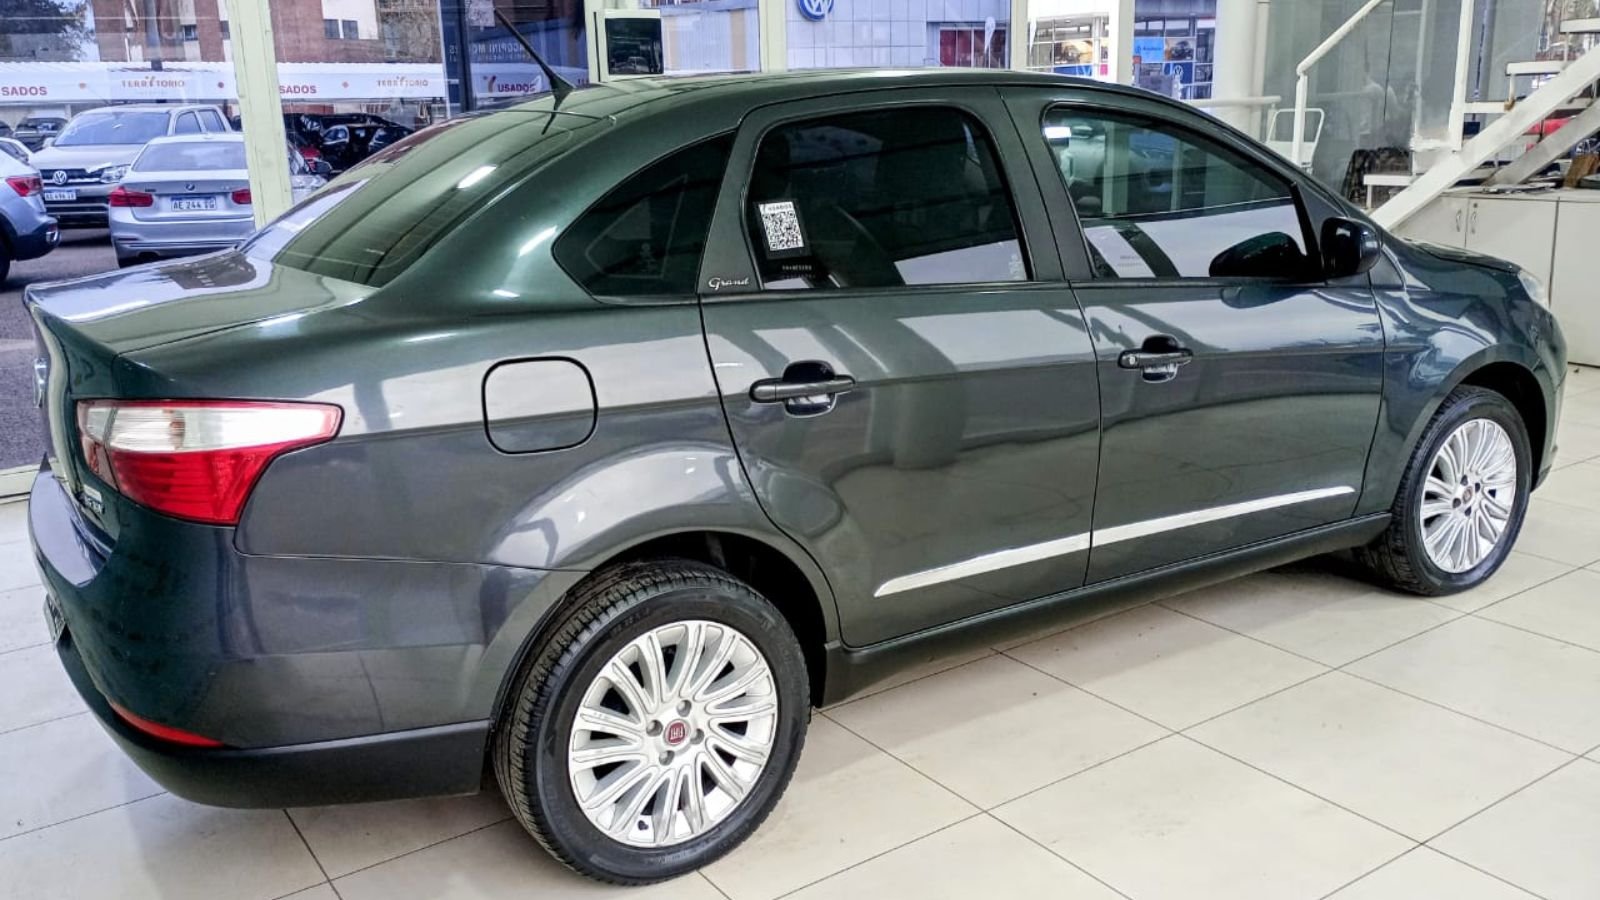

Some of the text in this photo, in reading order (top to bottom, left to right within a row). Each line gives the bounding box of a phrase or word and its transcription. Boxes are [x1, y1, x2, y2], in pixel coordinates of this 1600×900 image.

[122, 76, 185, 88] TERRITORIO
[377, 76, 429, 87] TERRITORIO
[1, 86, 48, 96] SADOS
[279, 85, 317, 94] SADOS
[498, 83, 536, 93] USADOS
[173, 201, 183, 209] AE
[708, 277, 750, 290] Grand
